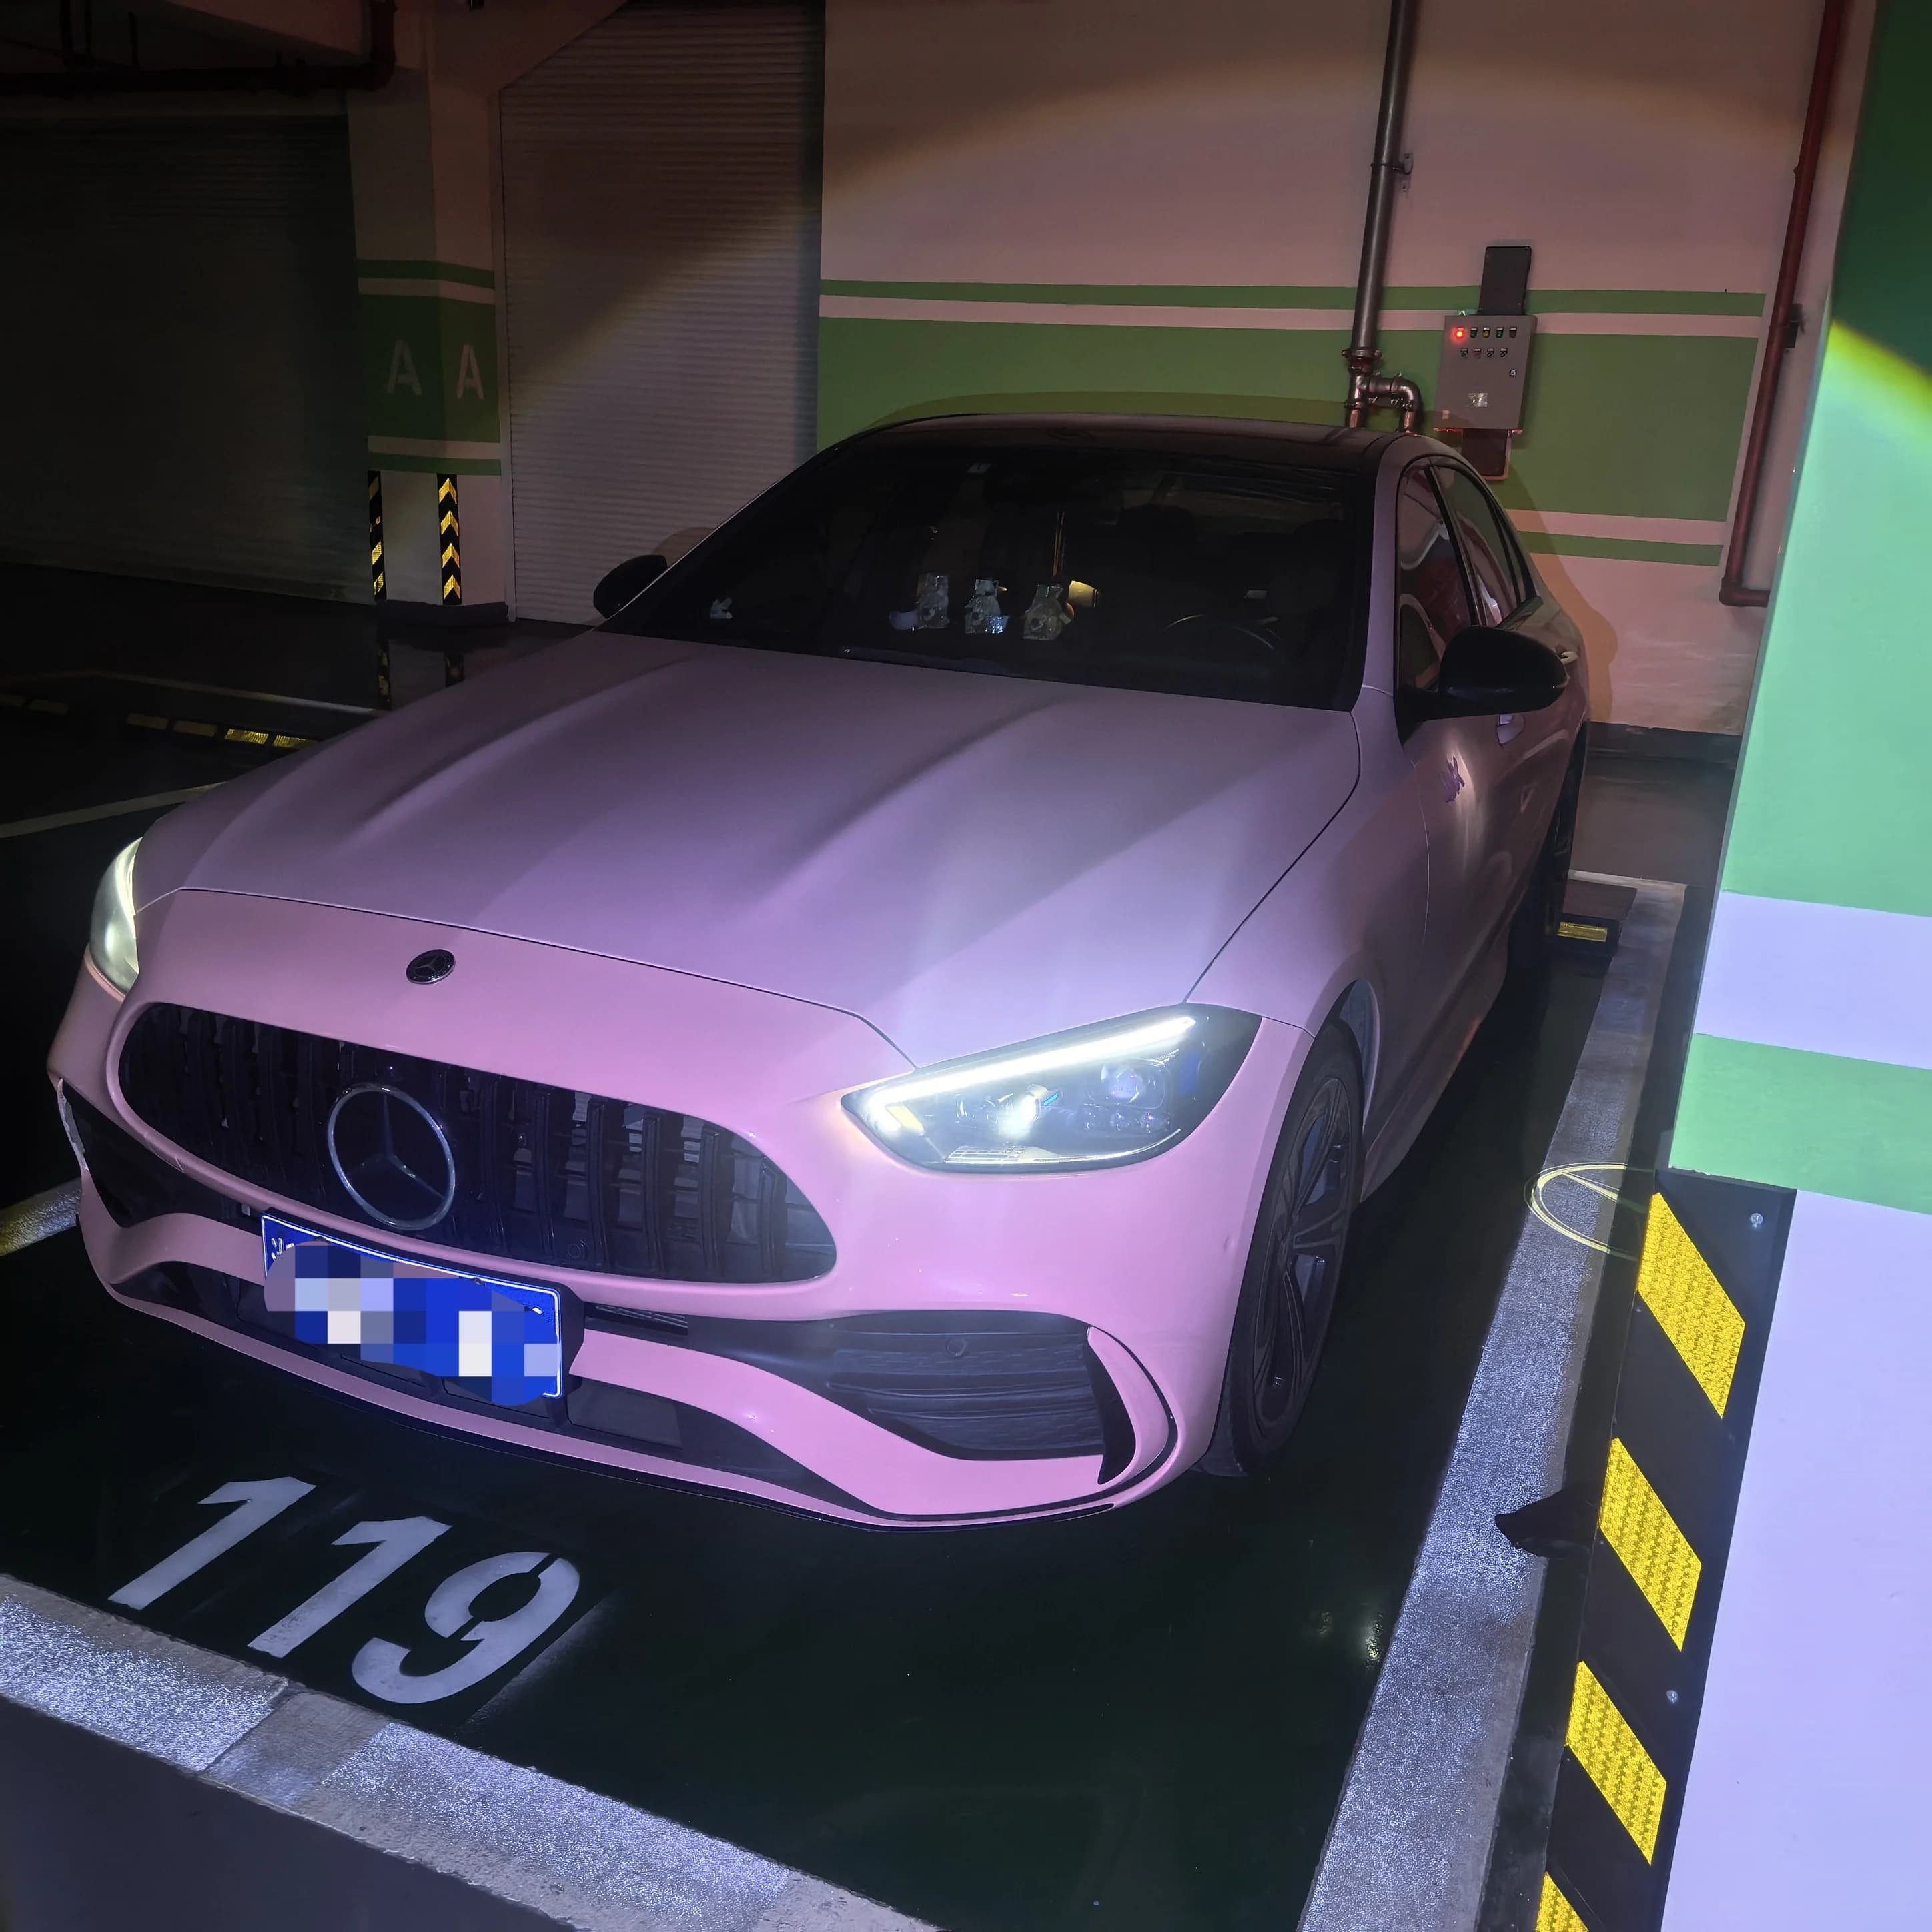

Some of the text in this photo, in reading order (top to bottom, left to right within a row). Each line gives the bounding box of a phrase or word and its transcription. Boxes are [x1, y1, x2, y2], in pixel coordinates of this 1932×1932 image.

[386, 338, 423, 396] A
[456, 343, 486, 400] A
[108, 1476, 580, 1704] 119
